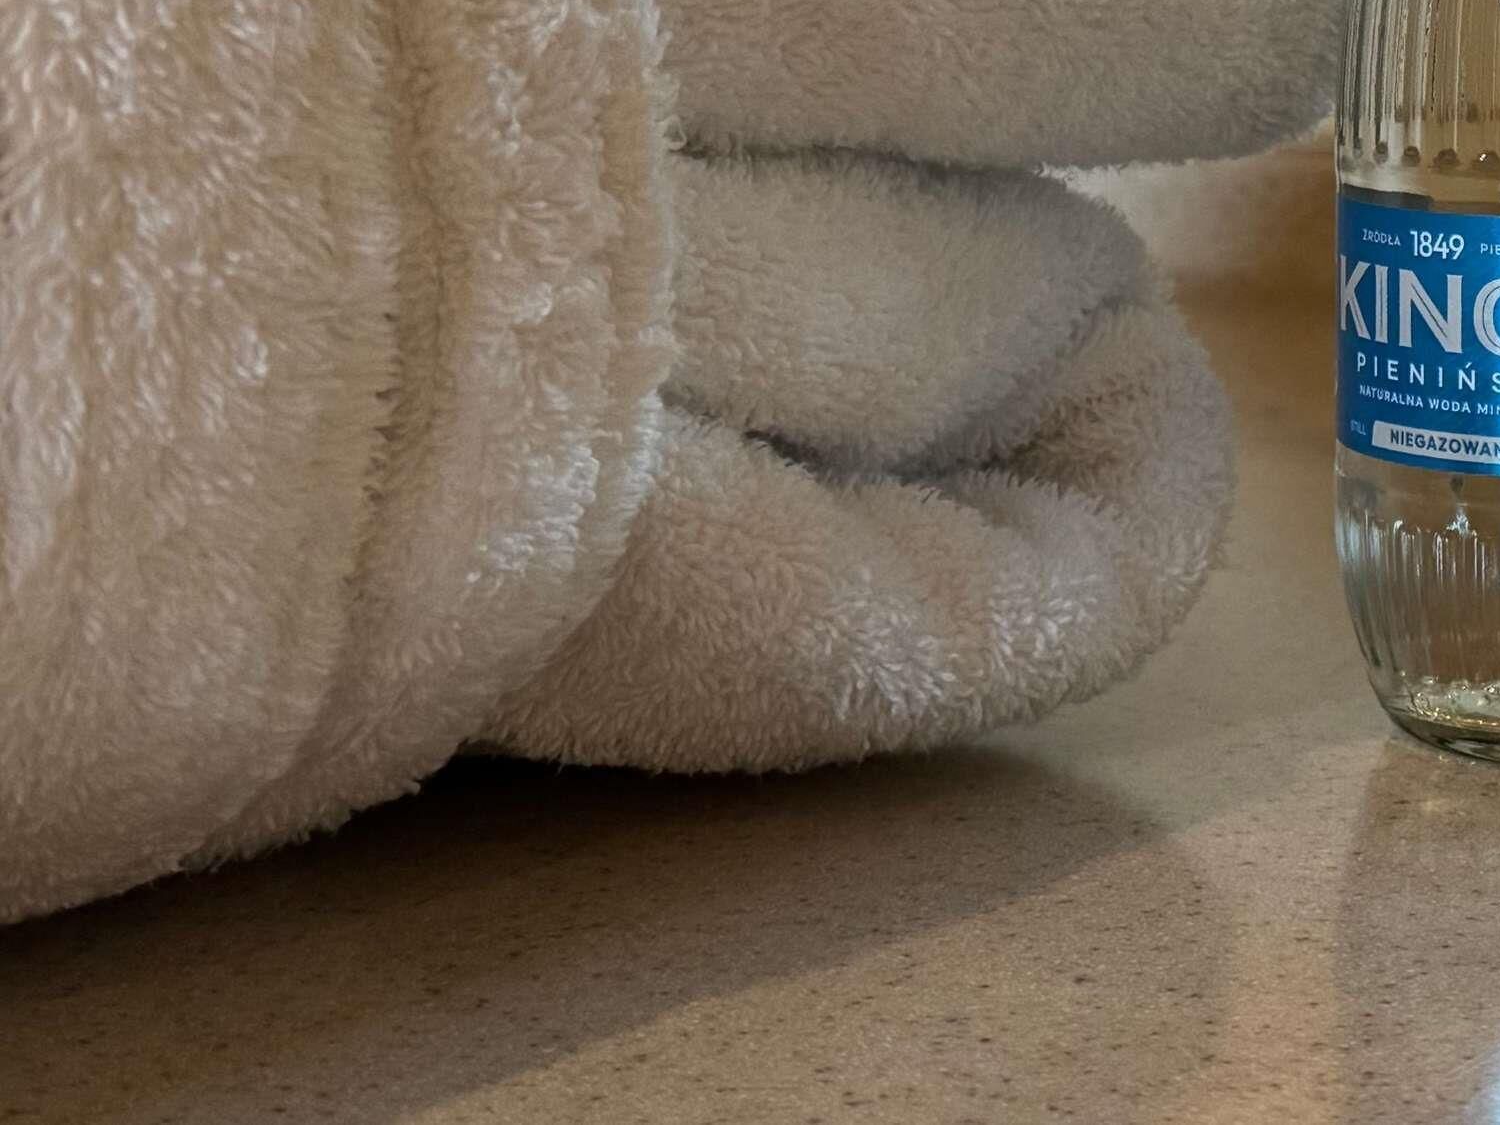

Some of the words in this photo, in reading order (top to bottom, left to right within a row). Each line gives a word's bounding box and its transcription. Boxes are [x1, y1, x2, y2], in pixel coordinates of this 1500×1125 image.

[1409, 230, 1466, 260] 1849
[1359, 384, 1424, 409] NATURALNA
[1428, 398, 1472, 414] WODA
